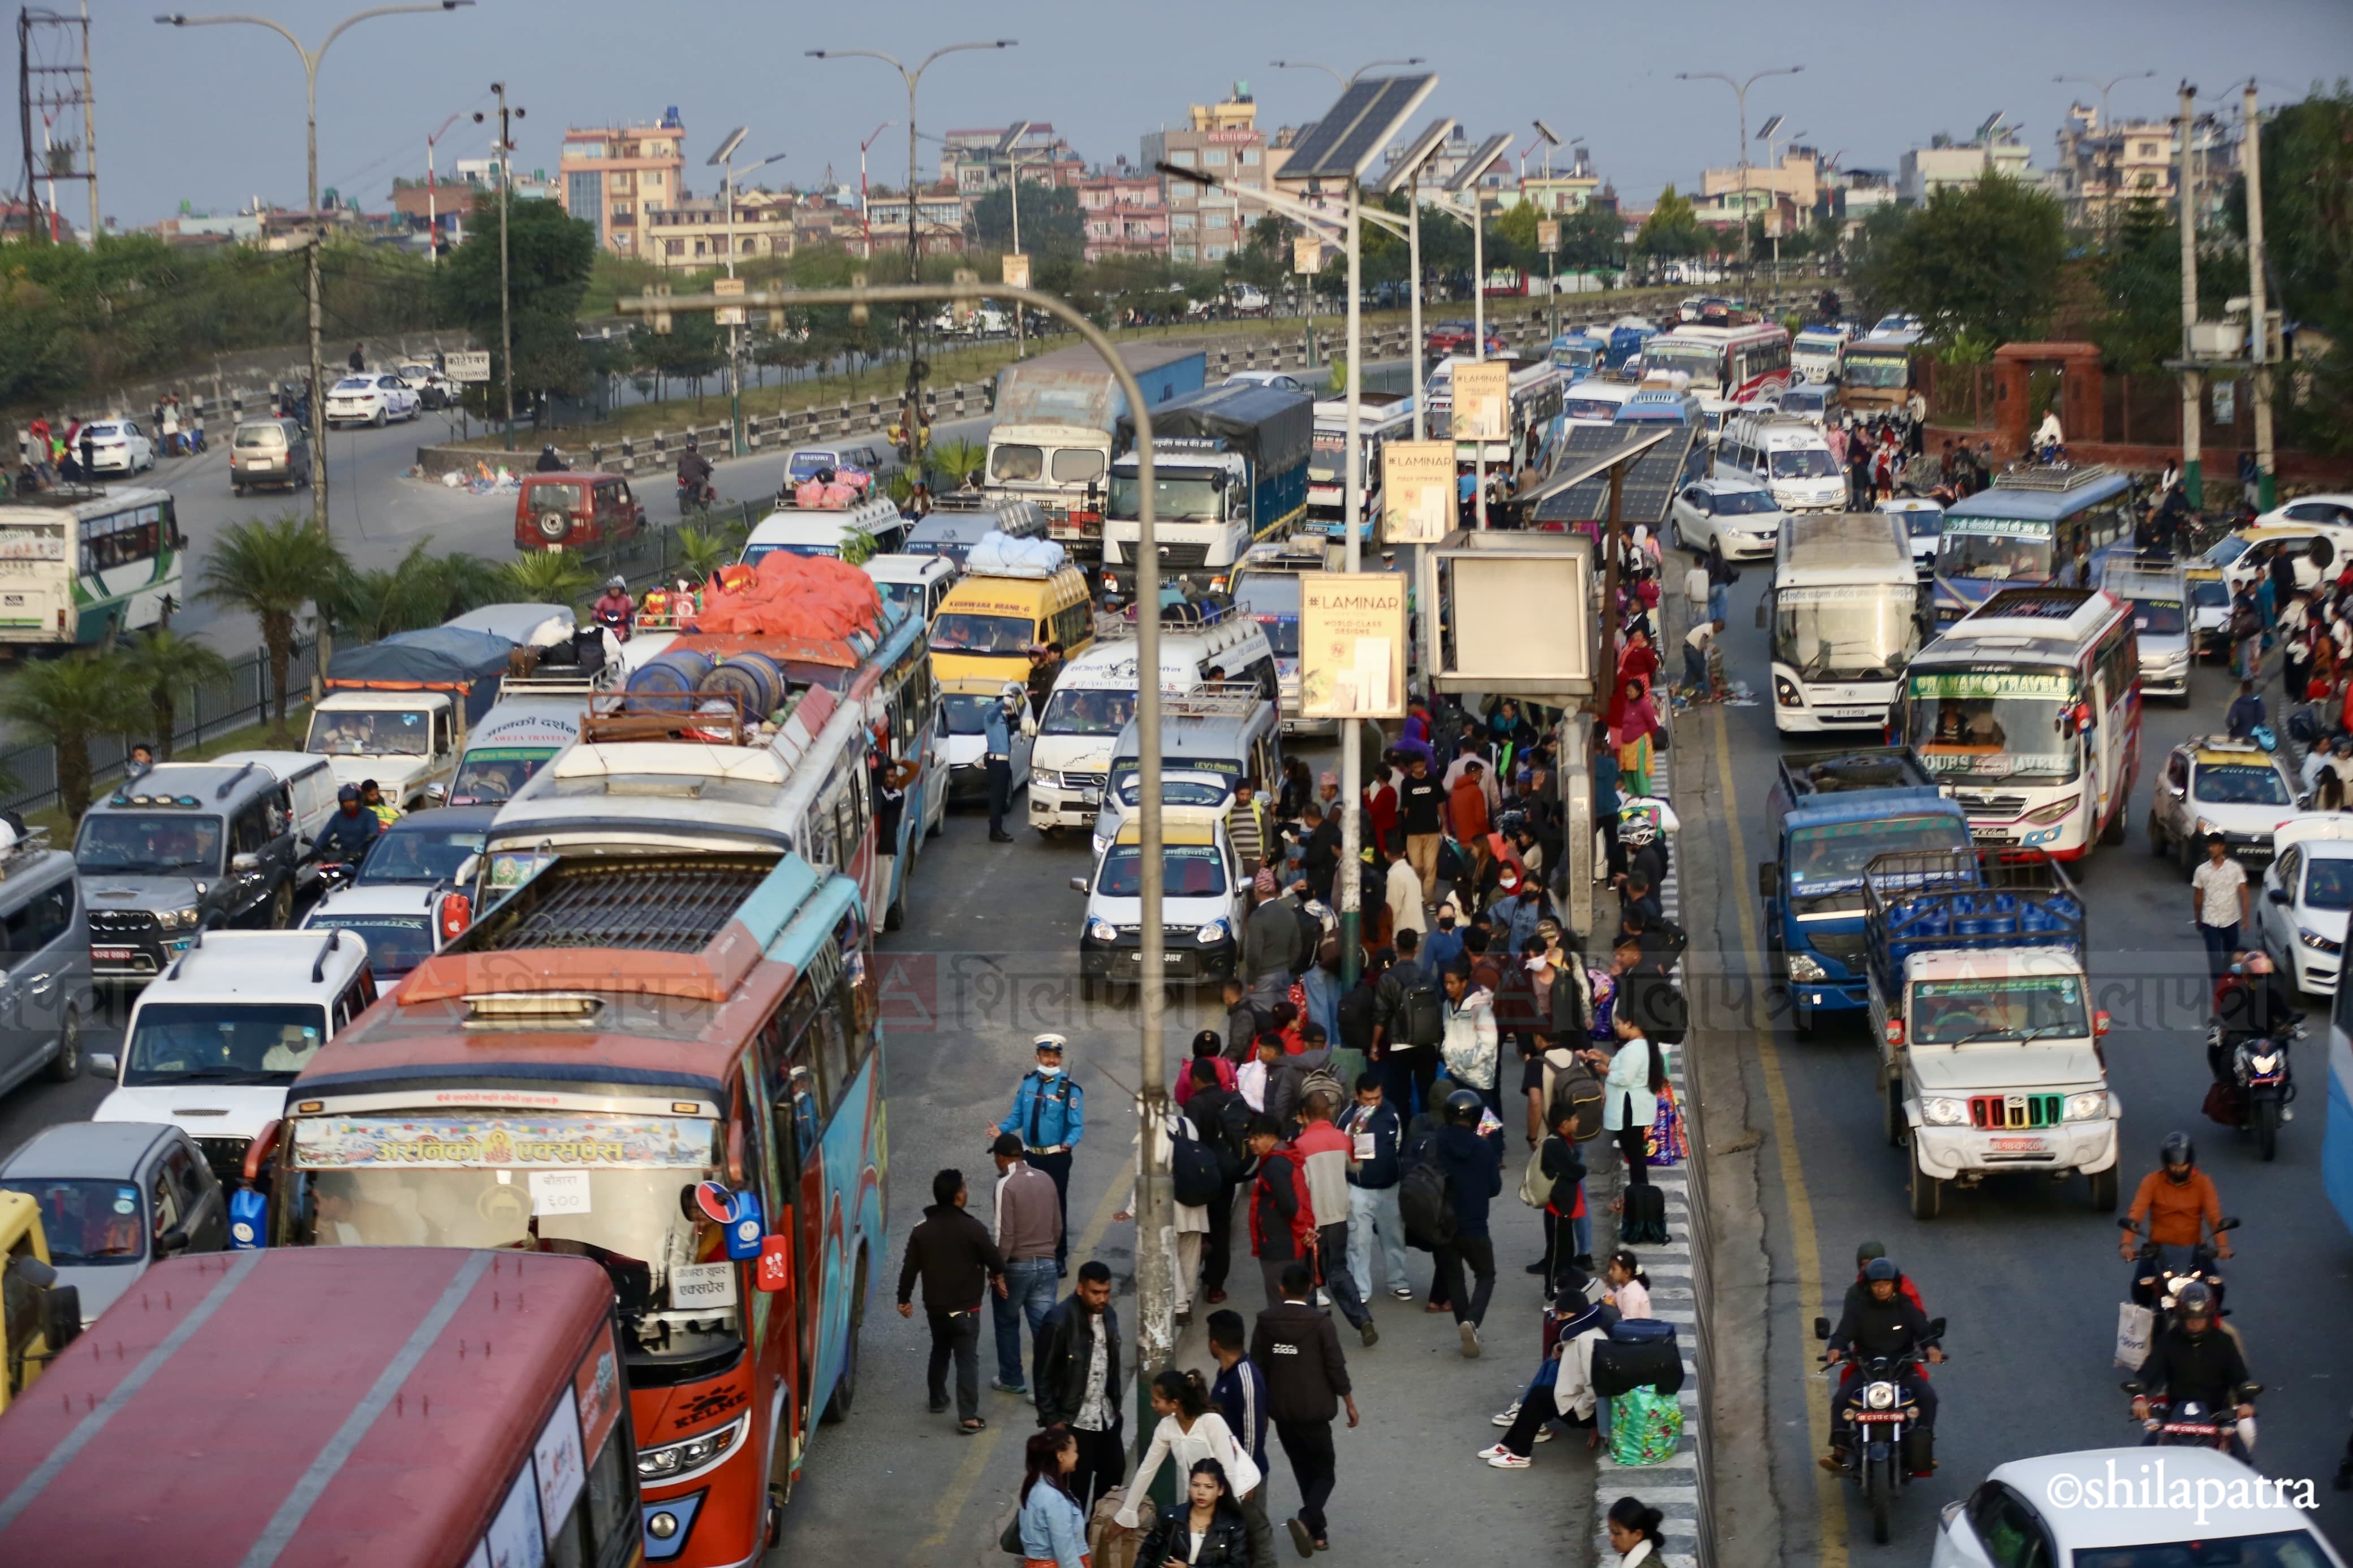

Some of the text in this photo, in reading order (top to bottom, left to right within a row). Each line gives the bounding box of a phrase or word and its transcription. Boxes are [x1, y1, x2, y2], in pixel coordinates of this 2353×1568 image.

[1387, 457, 1451, 467] #LAMINAR
[994, 602, 1019, 611] BRAND
[1308, 597, 1398, 611] #LAMINAR
[1916, 675, 2068, 693] PRANAM TRAVELS
[376, 1134, 482, 1163] अरनिको
[516, 1137, 626, 1164] एक्सप्रेस
[543, 1173, 579, 1186] चौतारा
[548, 1195, 580, 1209] ६००
[706, 1267, 729, 1277] सुपर
[679, 1281, 725, 1295] एक्सप्रेस
[1272, 1346, 1298, 1355] adidas
[674, 1391, 747, 1429] KELME
